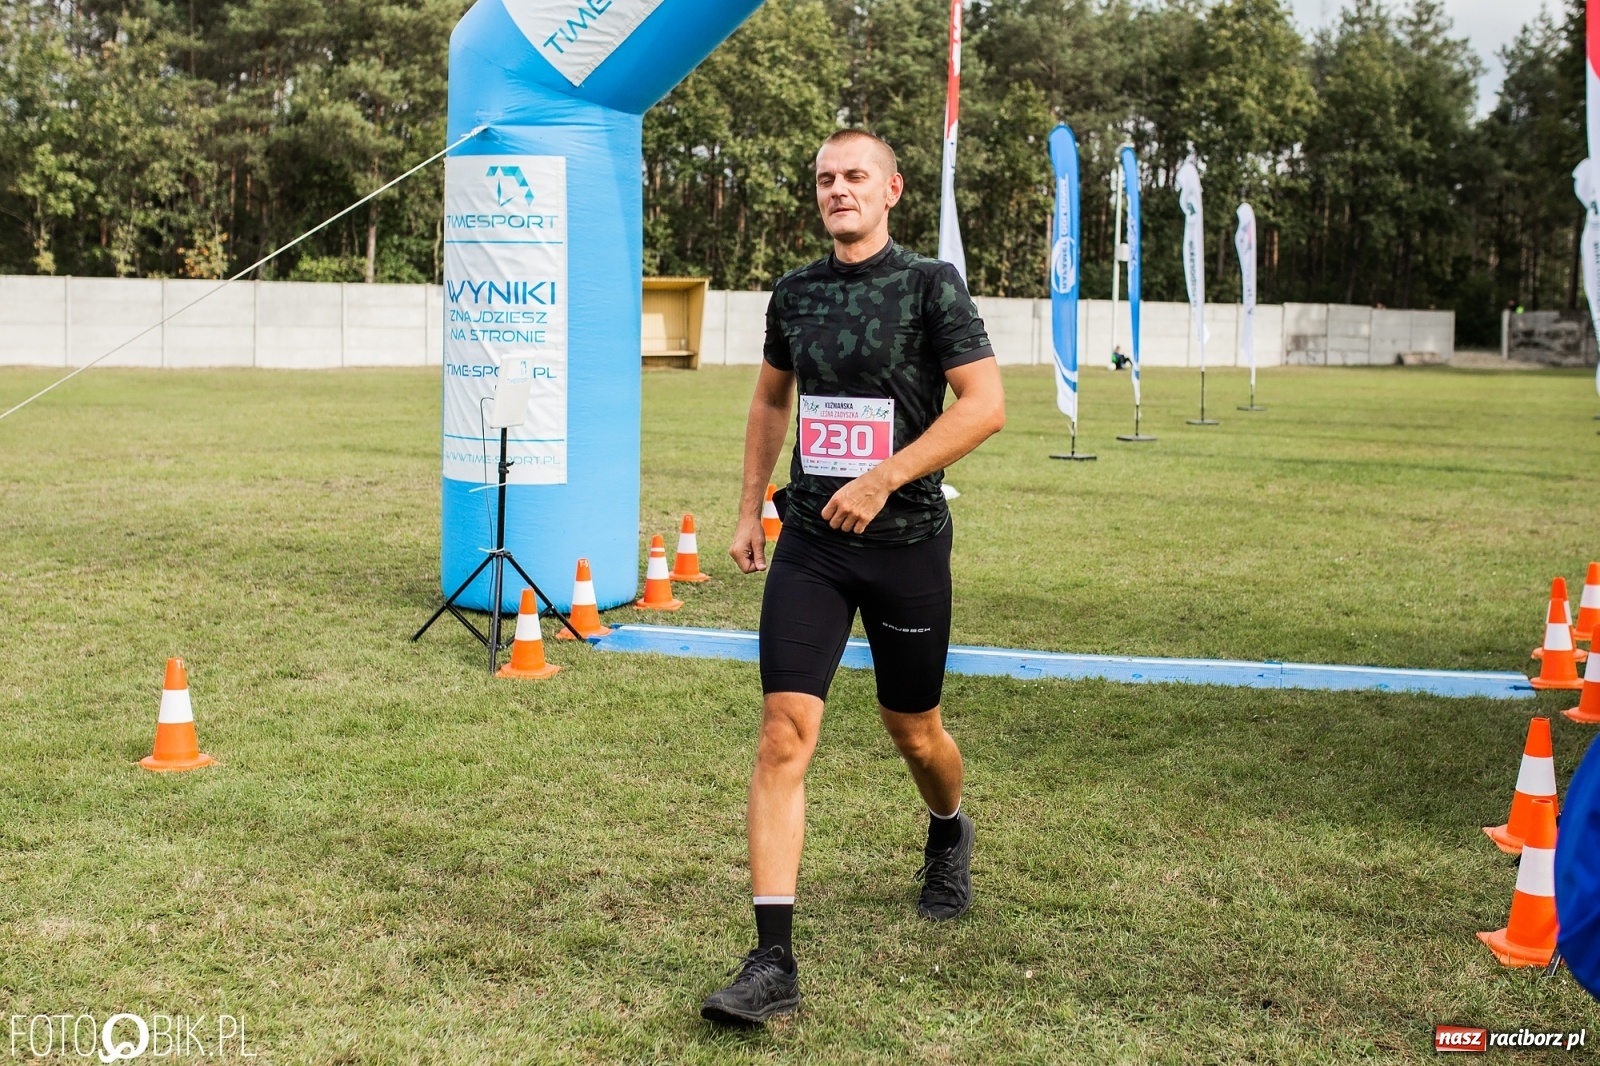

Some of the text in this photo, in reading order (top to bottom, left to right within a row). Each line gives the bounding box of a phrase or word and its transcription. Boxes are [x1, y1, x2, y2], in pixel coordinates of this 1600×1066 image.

[446, 214, 559, 229] TIMESPORT
[446, 279, 556, 305] WYNIKI
[450, 309, 547, 324] ZNAJDZIESZ
[451, 328, 546, 343] NA STRONIE
[809, 422, 874, 457] 230
